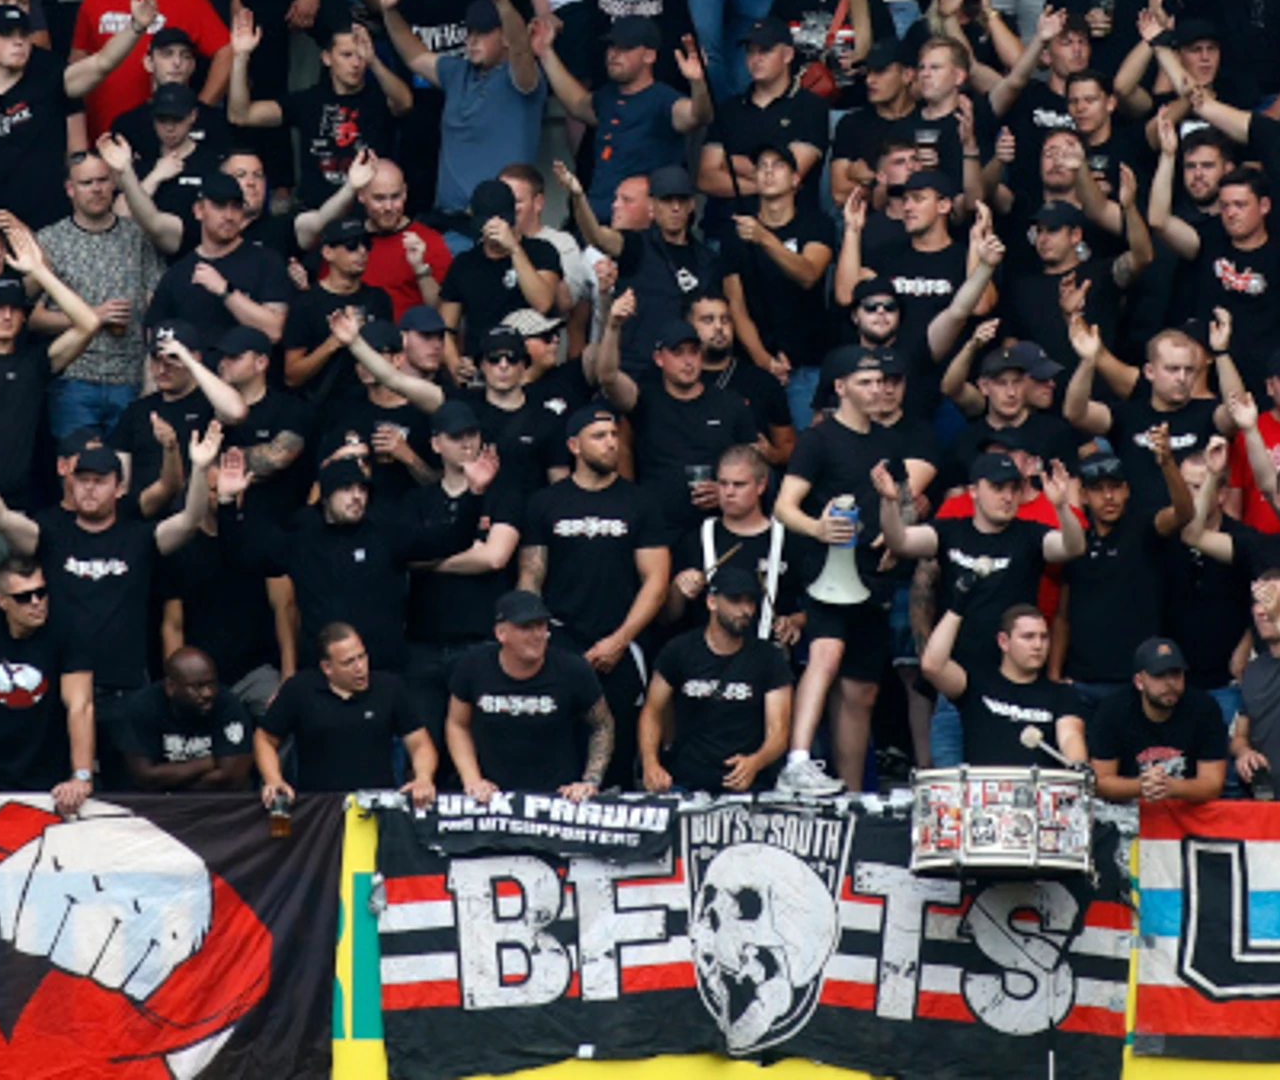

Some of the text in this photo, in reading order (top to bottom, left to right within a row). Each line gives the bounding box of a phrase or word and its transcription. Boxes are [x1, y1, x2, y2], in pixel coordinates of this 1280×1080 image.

[415, 791, 516, 819] UCK
[690, 809, 843, 862] BOYS SOUTH
